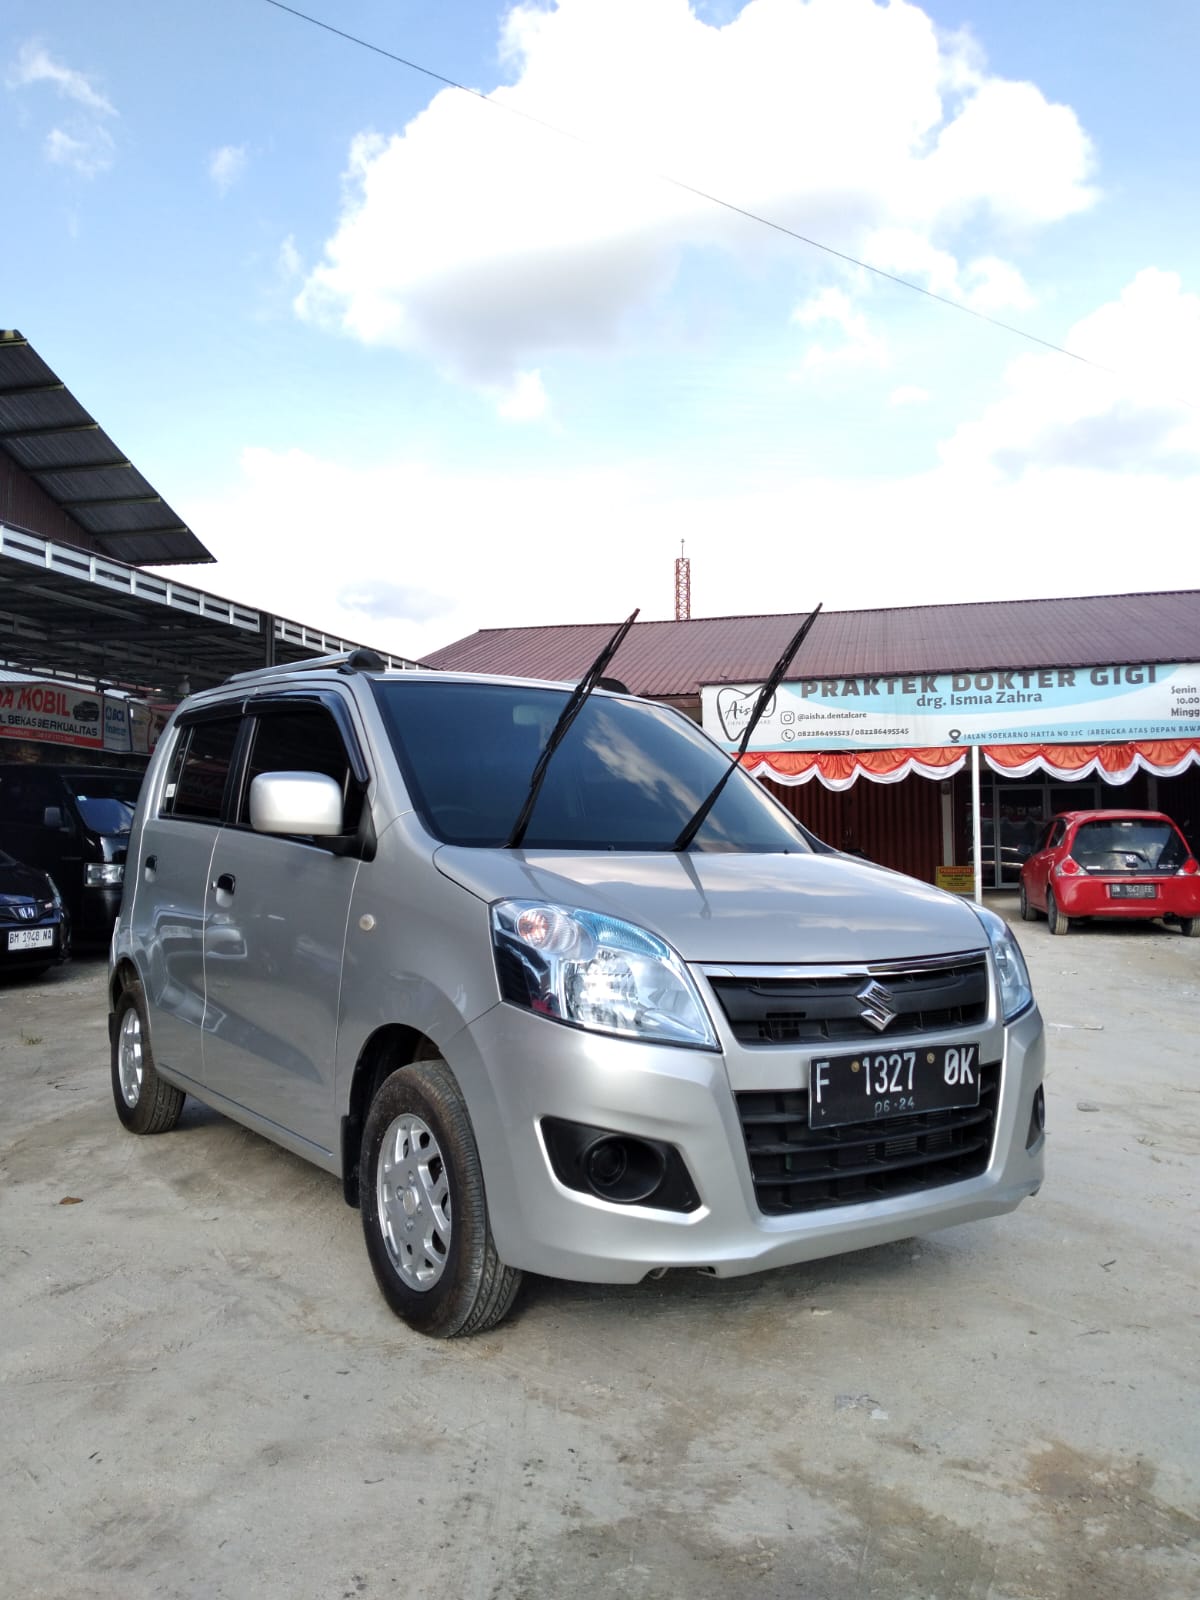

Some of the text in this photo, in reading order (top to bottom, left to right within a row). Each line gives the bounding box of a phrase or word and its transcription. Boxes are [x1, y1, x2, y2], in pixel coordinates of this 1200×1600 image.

[801, 665, 1156, 698] PRAKTEK DOKTER GIGI
[1171, 685, 1197, 694] Senin
[17, 687, 70, 717] MOBIL
[916, 690, 1042, 709] drg. Ismia Zahra
[1176, 697, 1200, 705] 10.00
[724, 700, 770, 721] Ais
[797, 711, 867, 722] @aisha.dentalcare
[1171, 707, 1200, 718] Mingg
[8, 715, 37, 728] BEKAS
[38, 718, 98, 737] BERKUALITAS
[988, 731, 1029, 739] SOEKARNO
[9, 932, 19, 943] BM
[816, 1062, 830, 1103] F
[862, 1051, 916, 1096] 1327
